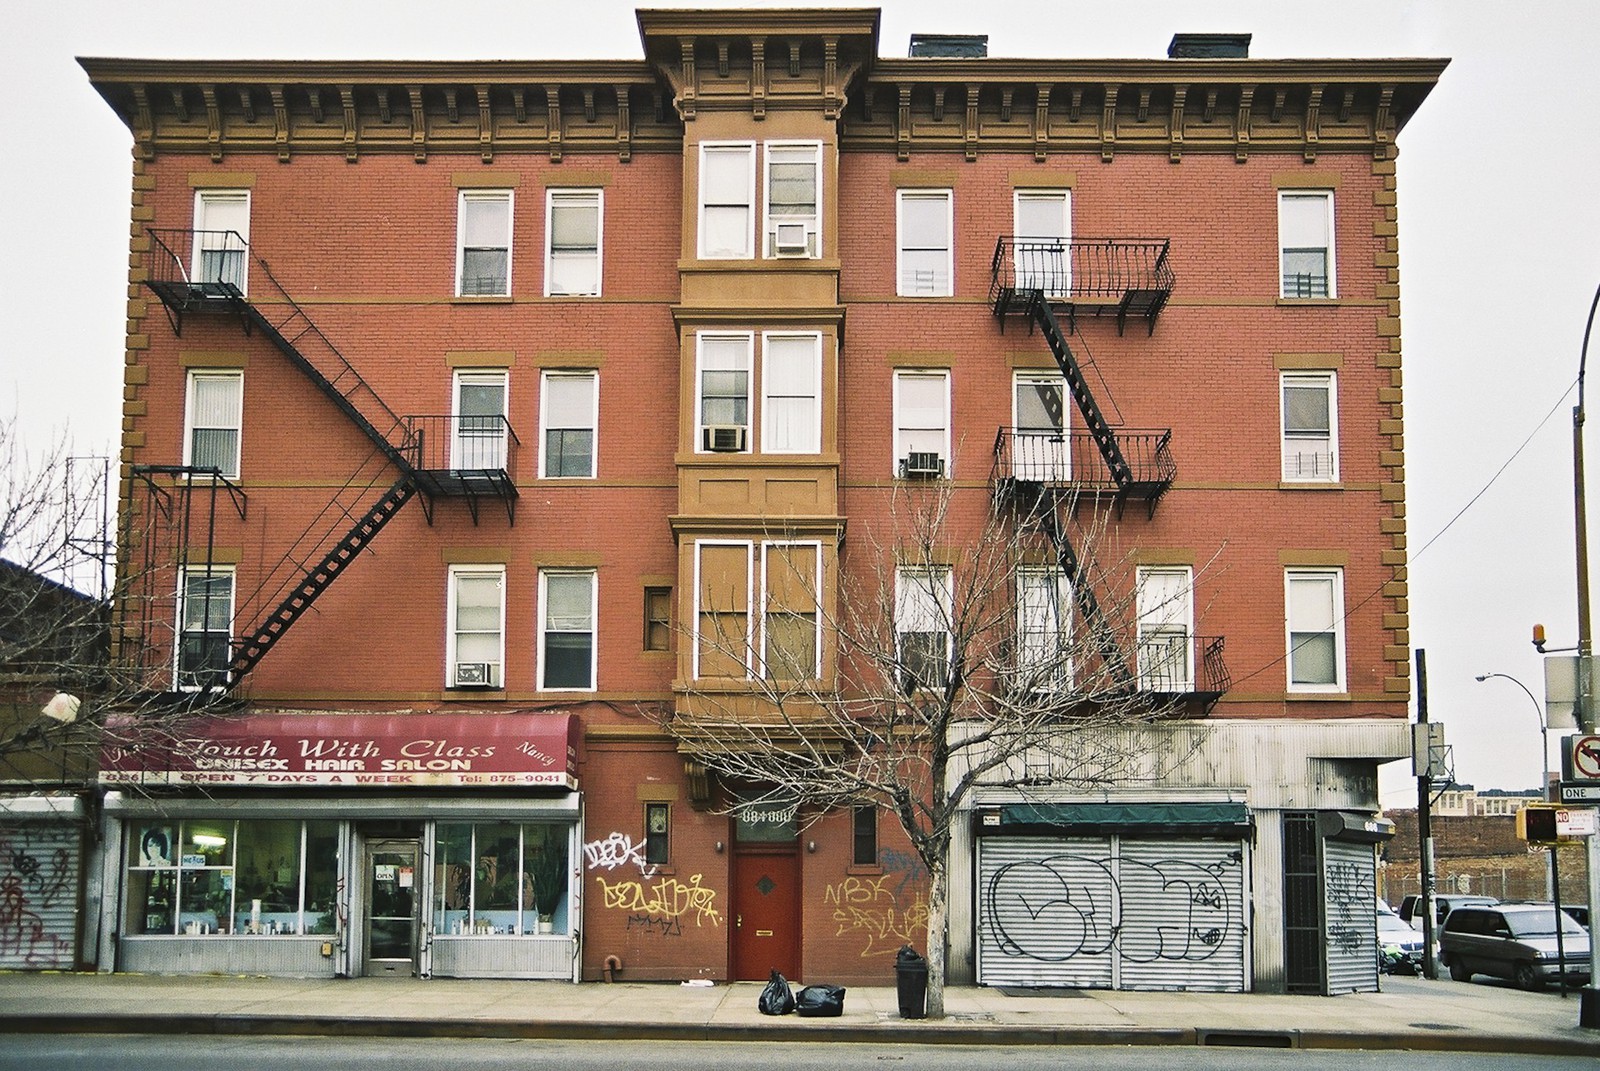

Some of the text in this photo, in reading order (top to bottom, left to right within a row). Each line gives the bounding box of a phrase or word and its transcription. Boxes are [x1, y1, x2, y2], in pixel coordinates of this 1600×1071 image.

[173, 739, 496, 757] Touch With Class
[516, 741, 556, 766] Nancy
[196, 758, 471, 771] UNISEX HAIR SALON
[180, 773, 235, 782] OPEN
[268, 774, 317, 782] DAYS
[490, 774, 560, 782] 875-9041
[1565, 788, 1587, 798] ONE
